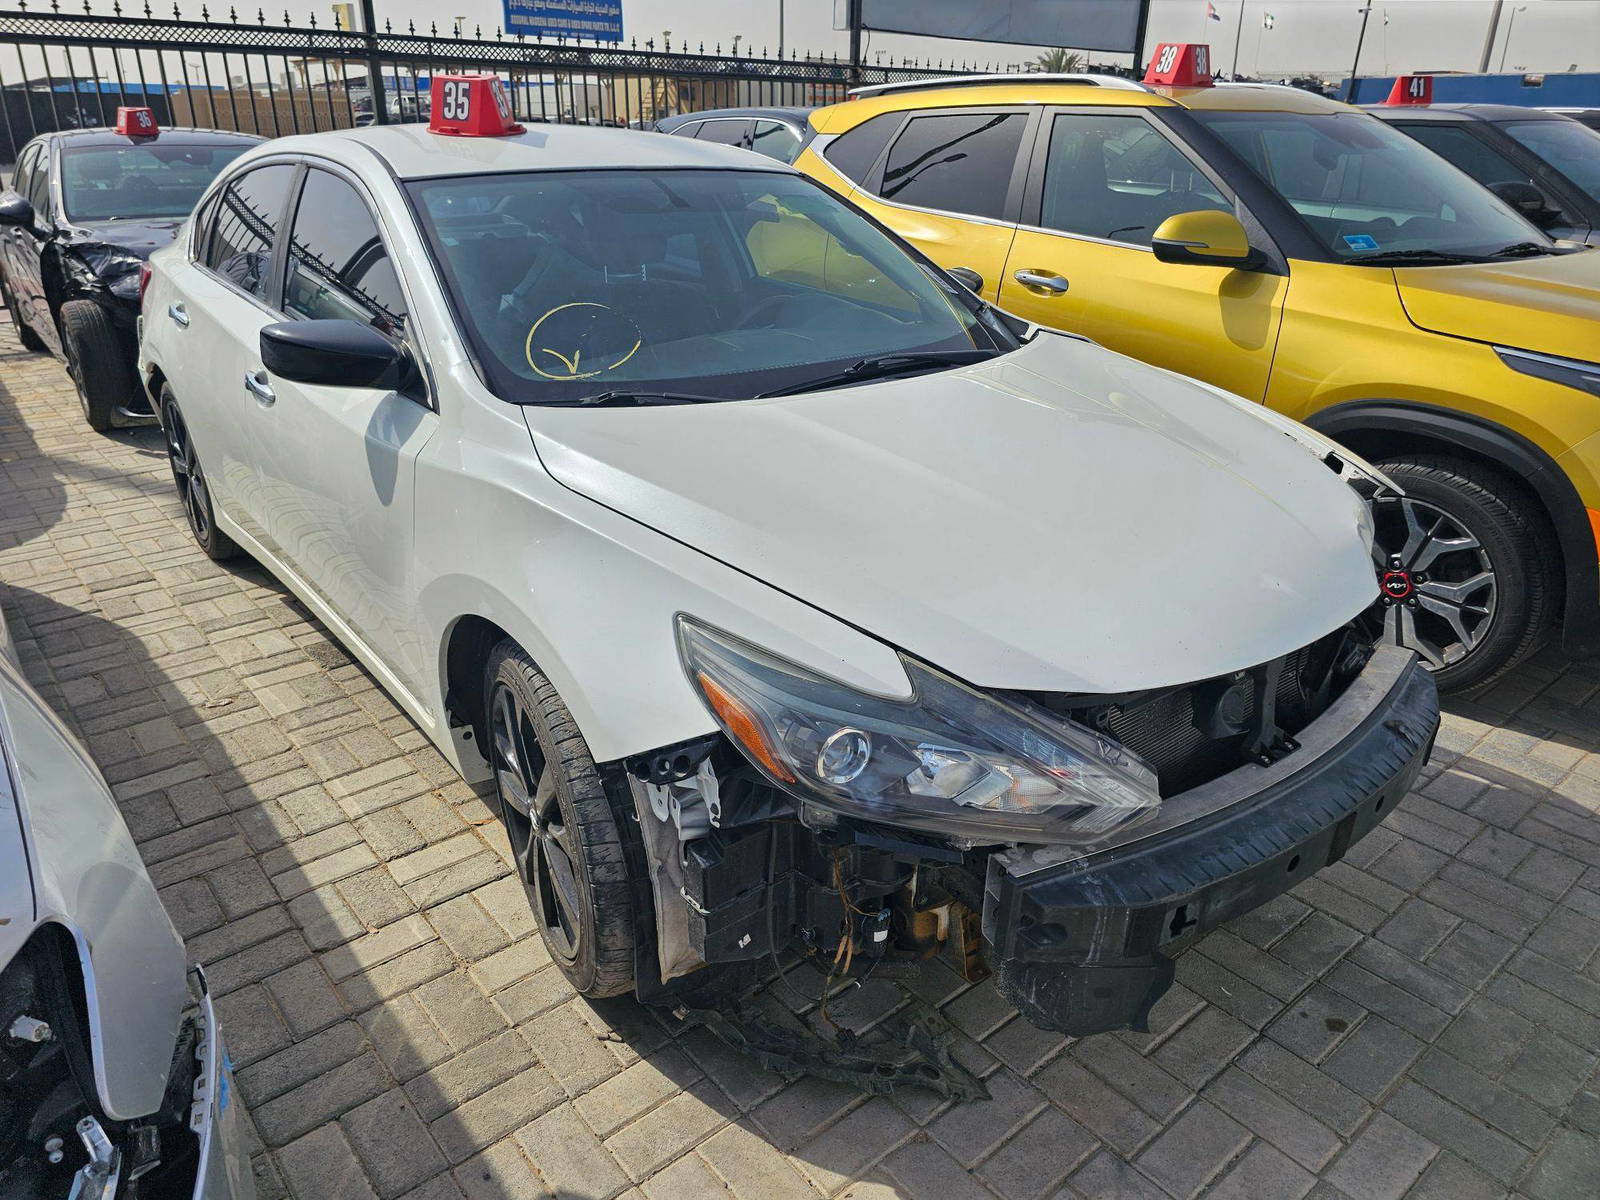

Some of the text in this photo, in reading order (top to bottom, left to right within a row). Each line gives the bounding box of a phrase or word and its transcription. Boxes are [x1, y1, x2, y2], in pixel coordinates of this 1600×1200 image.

[1155, 46, 1178, 74] 38
[1195, 47, 1207, 75] 38
[444, 81, 470, 120] 35
[1409, 77, 1425, 97] 41
[136, 111, 152, 128] 36
